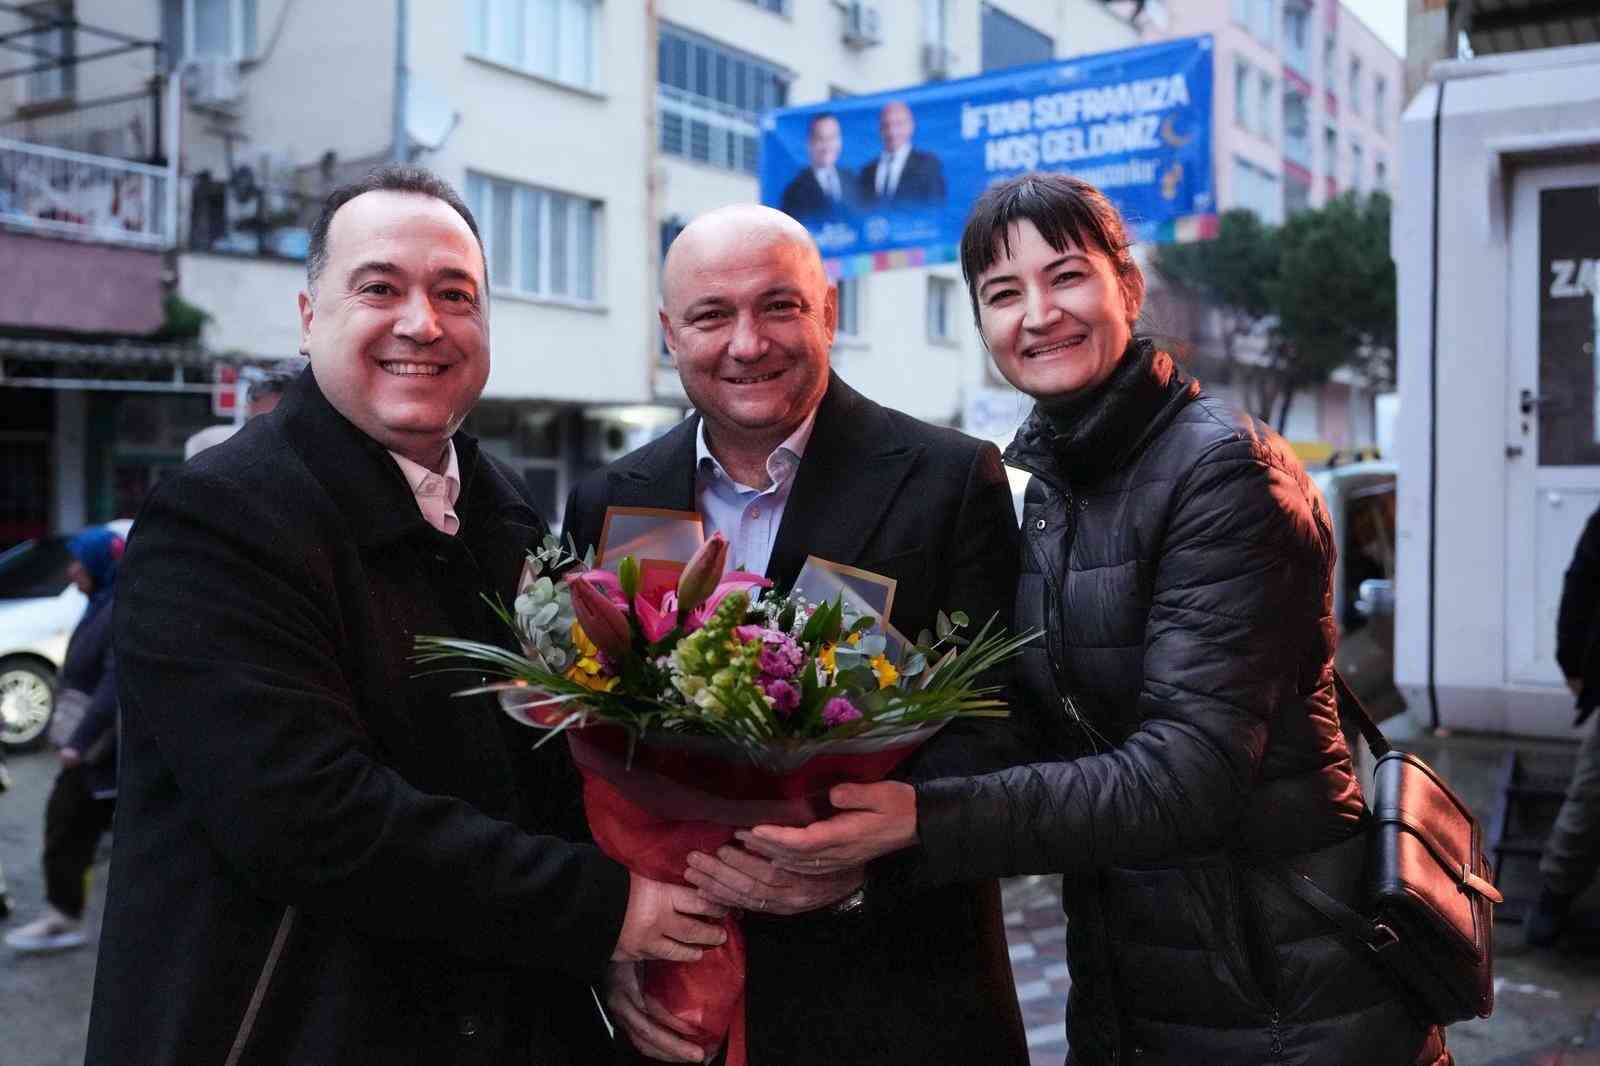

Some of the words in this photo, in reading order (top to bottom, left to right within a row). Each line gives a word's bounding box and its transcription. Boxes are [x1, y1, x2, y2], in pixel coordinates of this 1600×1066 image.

[961, 98, 1032, 139] İFTAR
[1033, 73, 1190, 128] SOFRAMIZA
[985, 132, 1039, 172] HOŞ
[1041, 114, 1161, 164] GELDİNİZ
